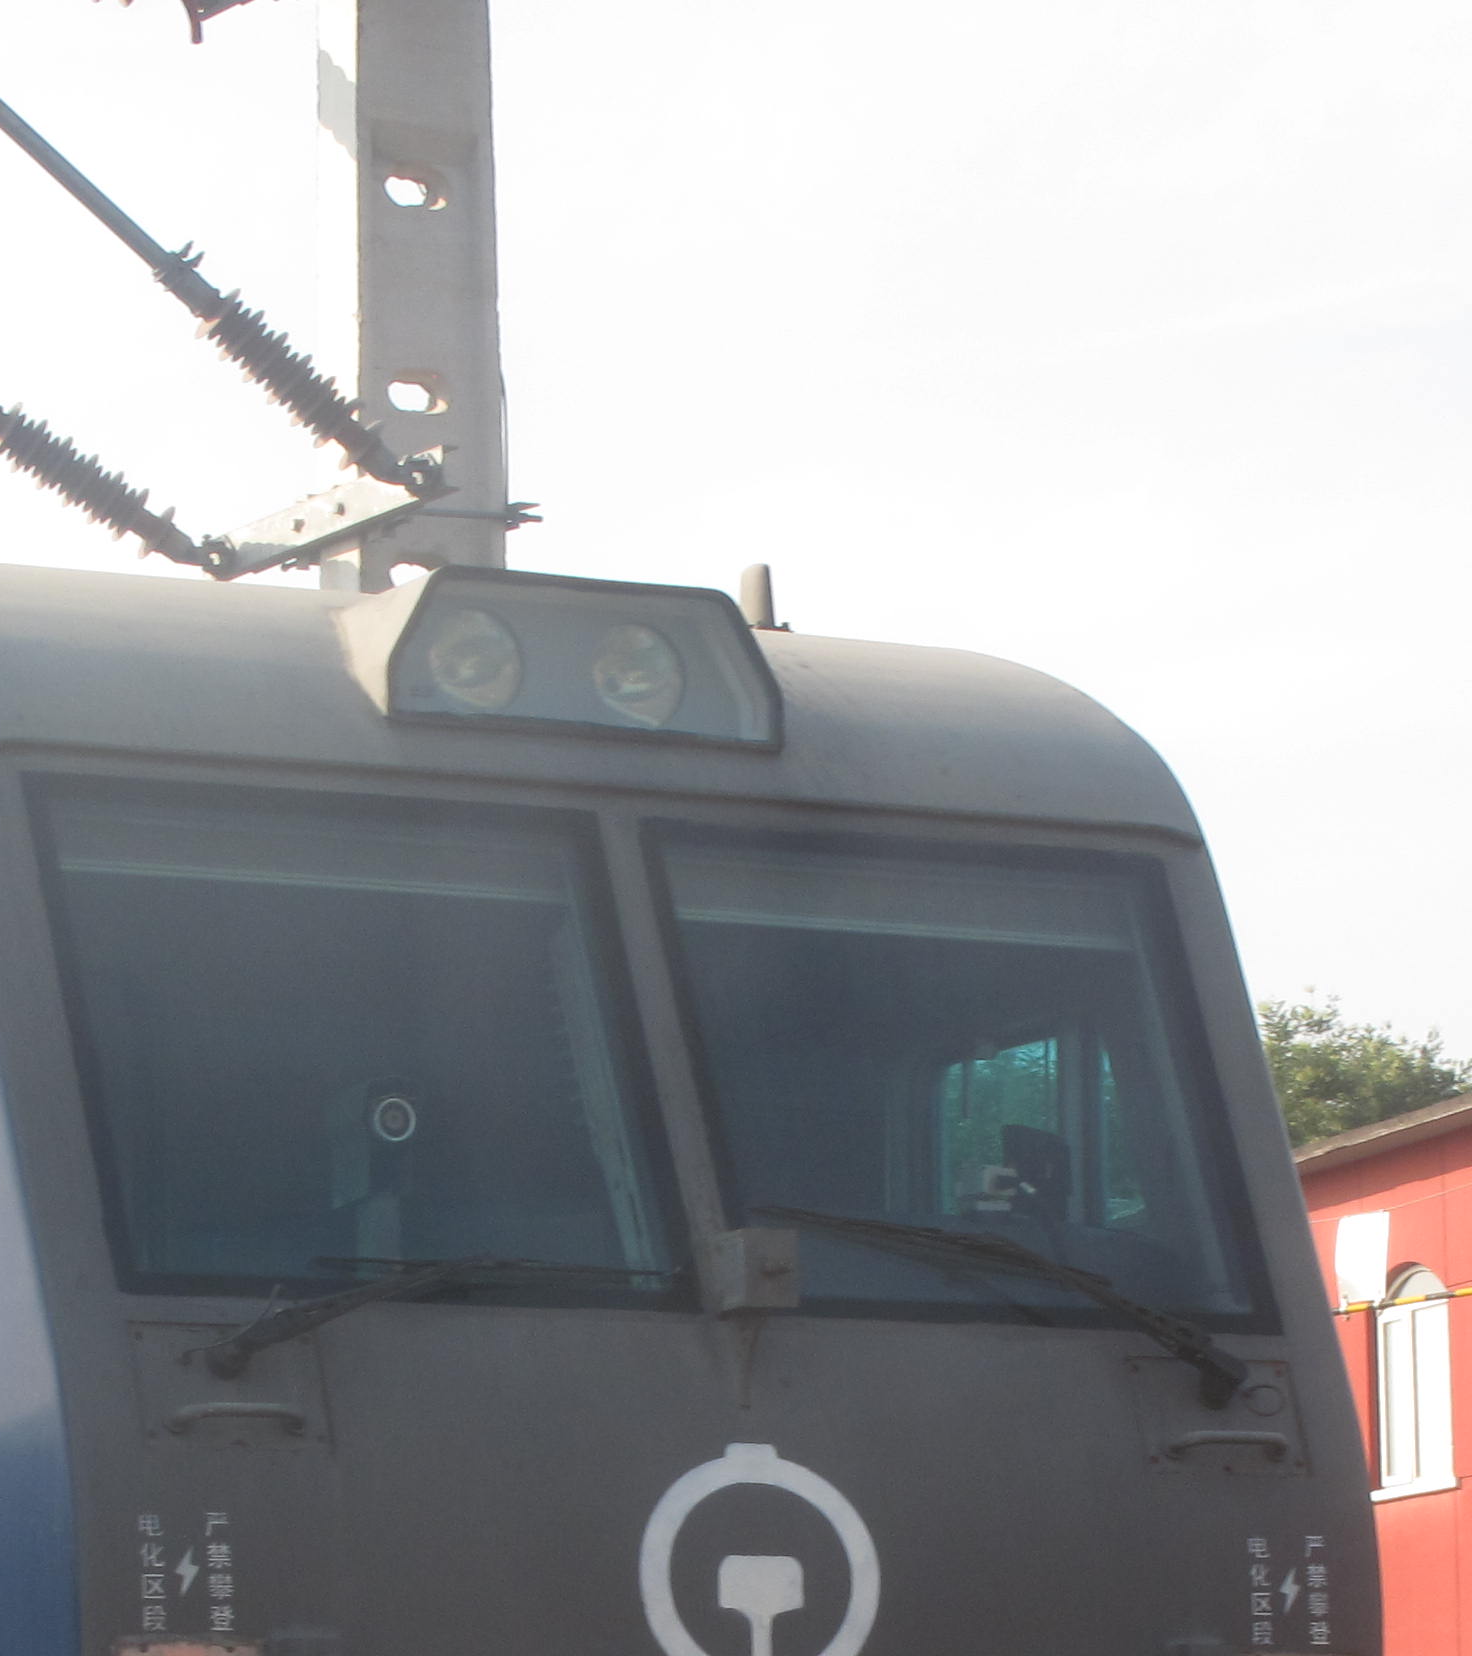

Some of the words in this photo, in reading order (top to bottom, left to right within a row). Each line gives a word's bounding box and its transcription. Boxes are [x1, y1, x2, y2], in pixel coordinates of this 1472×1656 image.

[137, 1514, 167, 1632] 电化区段
[205, 1511, 235, 1632] 严禁攀登
